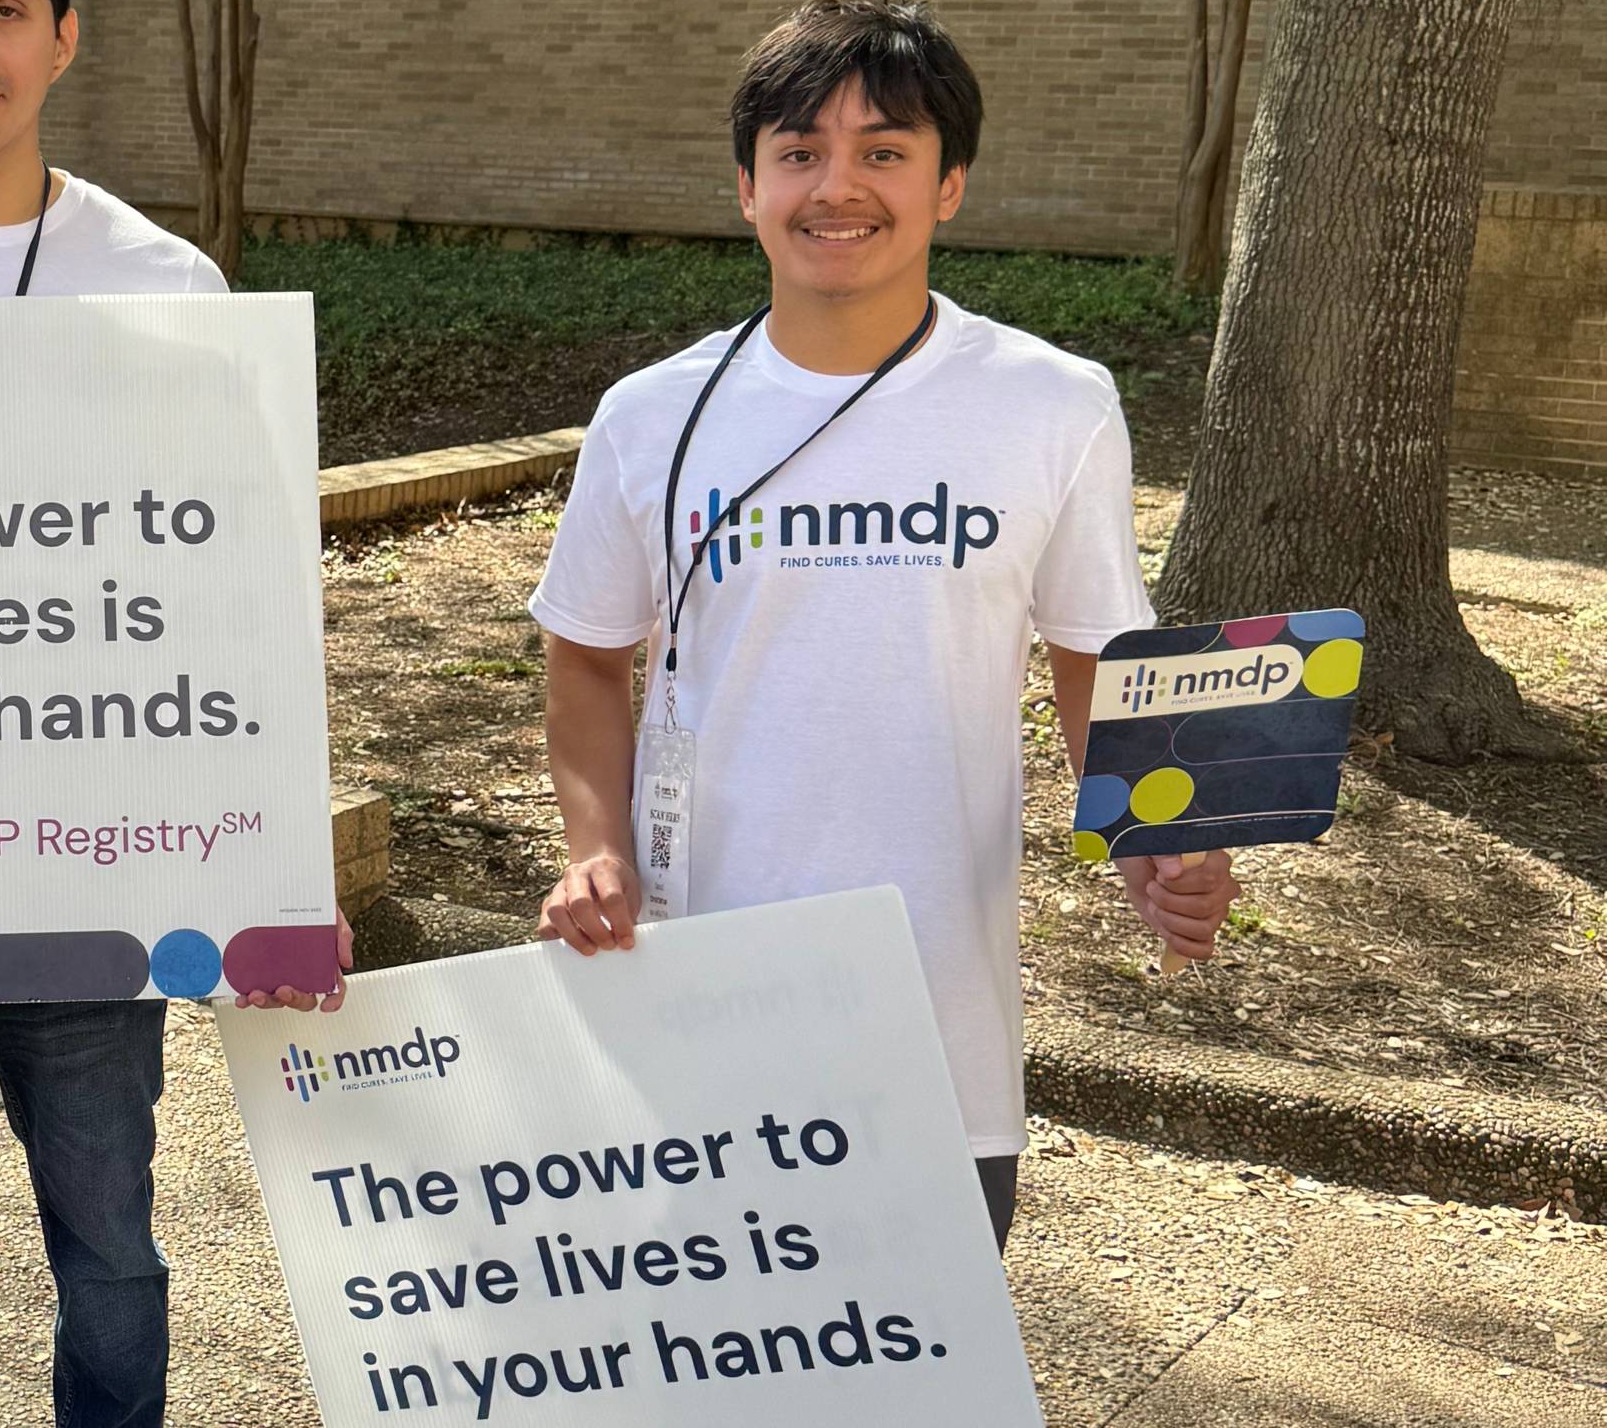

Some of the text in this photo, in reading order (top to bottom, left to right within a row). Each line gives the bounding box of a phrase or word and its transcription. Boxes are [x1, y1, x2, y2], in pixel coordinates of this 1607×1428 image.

[133, 489, 215, 545] to
[780, 481, 1000, 570] nmdp
[780, 554, 945, 568] FIND CURES. SAVE LIVES.
[103, 580, 165, 641] is
[1173, 654, 1290, 696] nmdp
[333, 1026, 461, 1079] nmdp
[312, 1114, 849, 1227] The power to
[345, 1212, 819, 1319] save lives is
[363, 1301, 947, 1420] in your hands.
